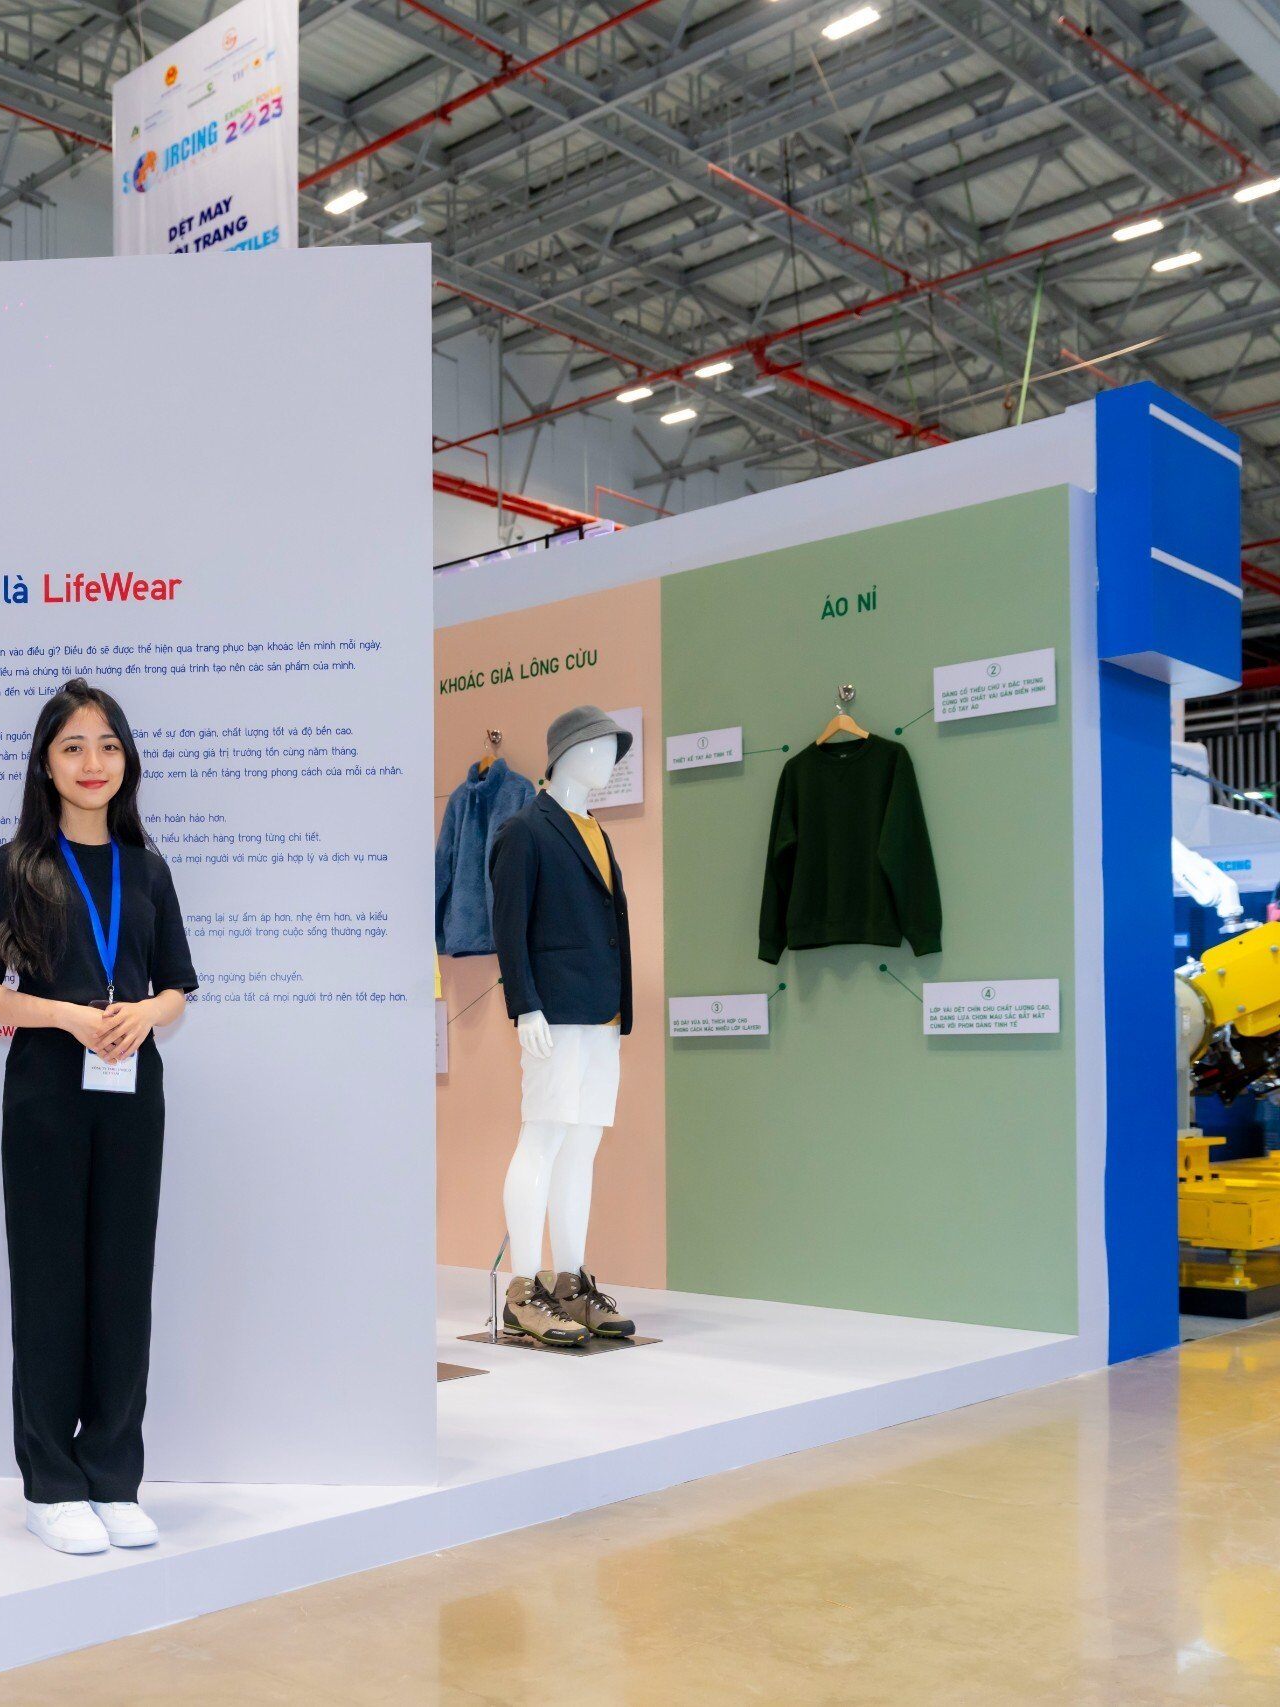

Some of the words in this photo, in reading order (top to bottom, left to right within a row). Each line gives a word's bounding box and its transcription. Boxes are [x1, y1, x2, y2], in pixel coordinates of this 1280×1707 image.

[225, 96, 283, 144] 2023
[168, 216, 195, 243] DỆT
[199, 195, 233, 227] MAY
[193, 215, 248, 253] TRANG
[3, 575, 29, 604] là
[43, 571, 182, 603] LifeWear
[820, 595, 848, 620] ÁO
[858, 585, 877, 612] NỈ
[439, 669, 485, 695] KHOÁC
[490, 662, 514, 686] GIẢ
[520, 657, 559, 680] LÔNG
[565, 648, 598, 671] CỪU
[38, 686, 60, 697] Life
